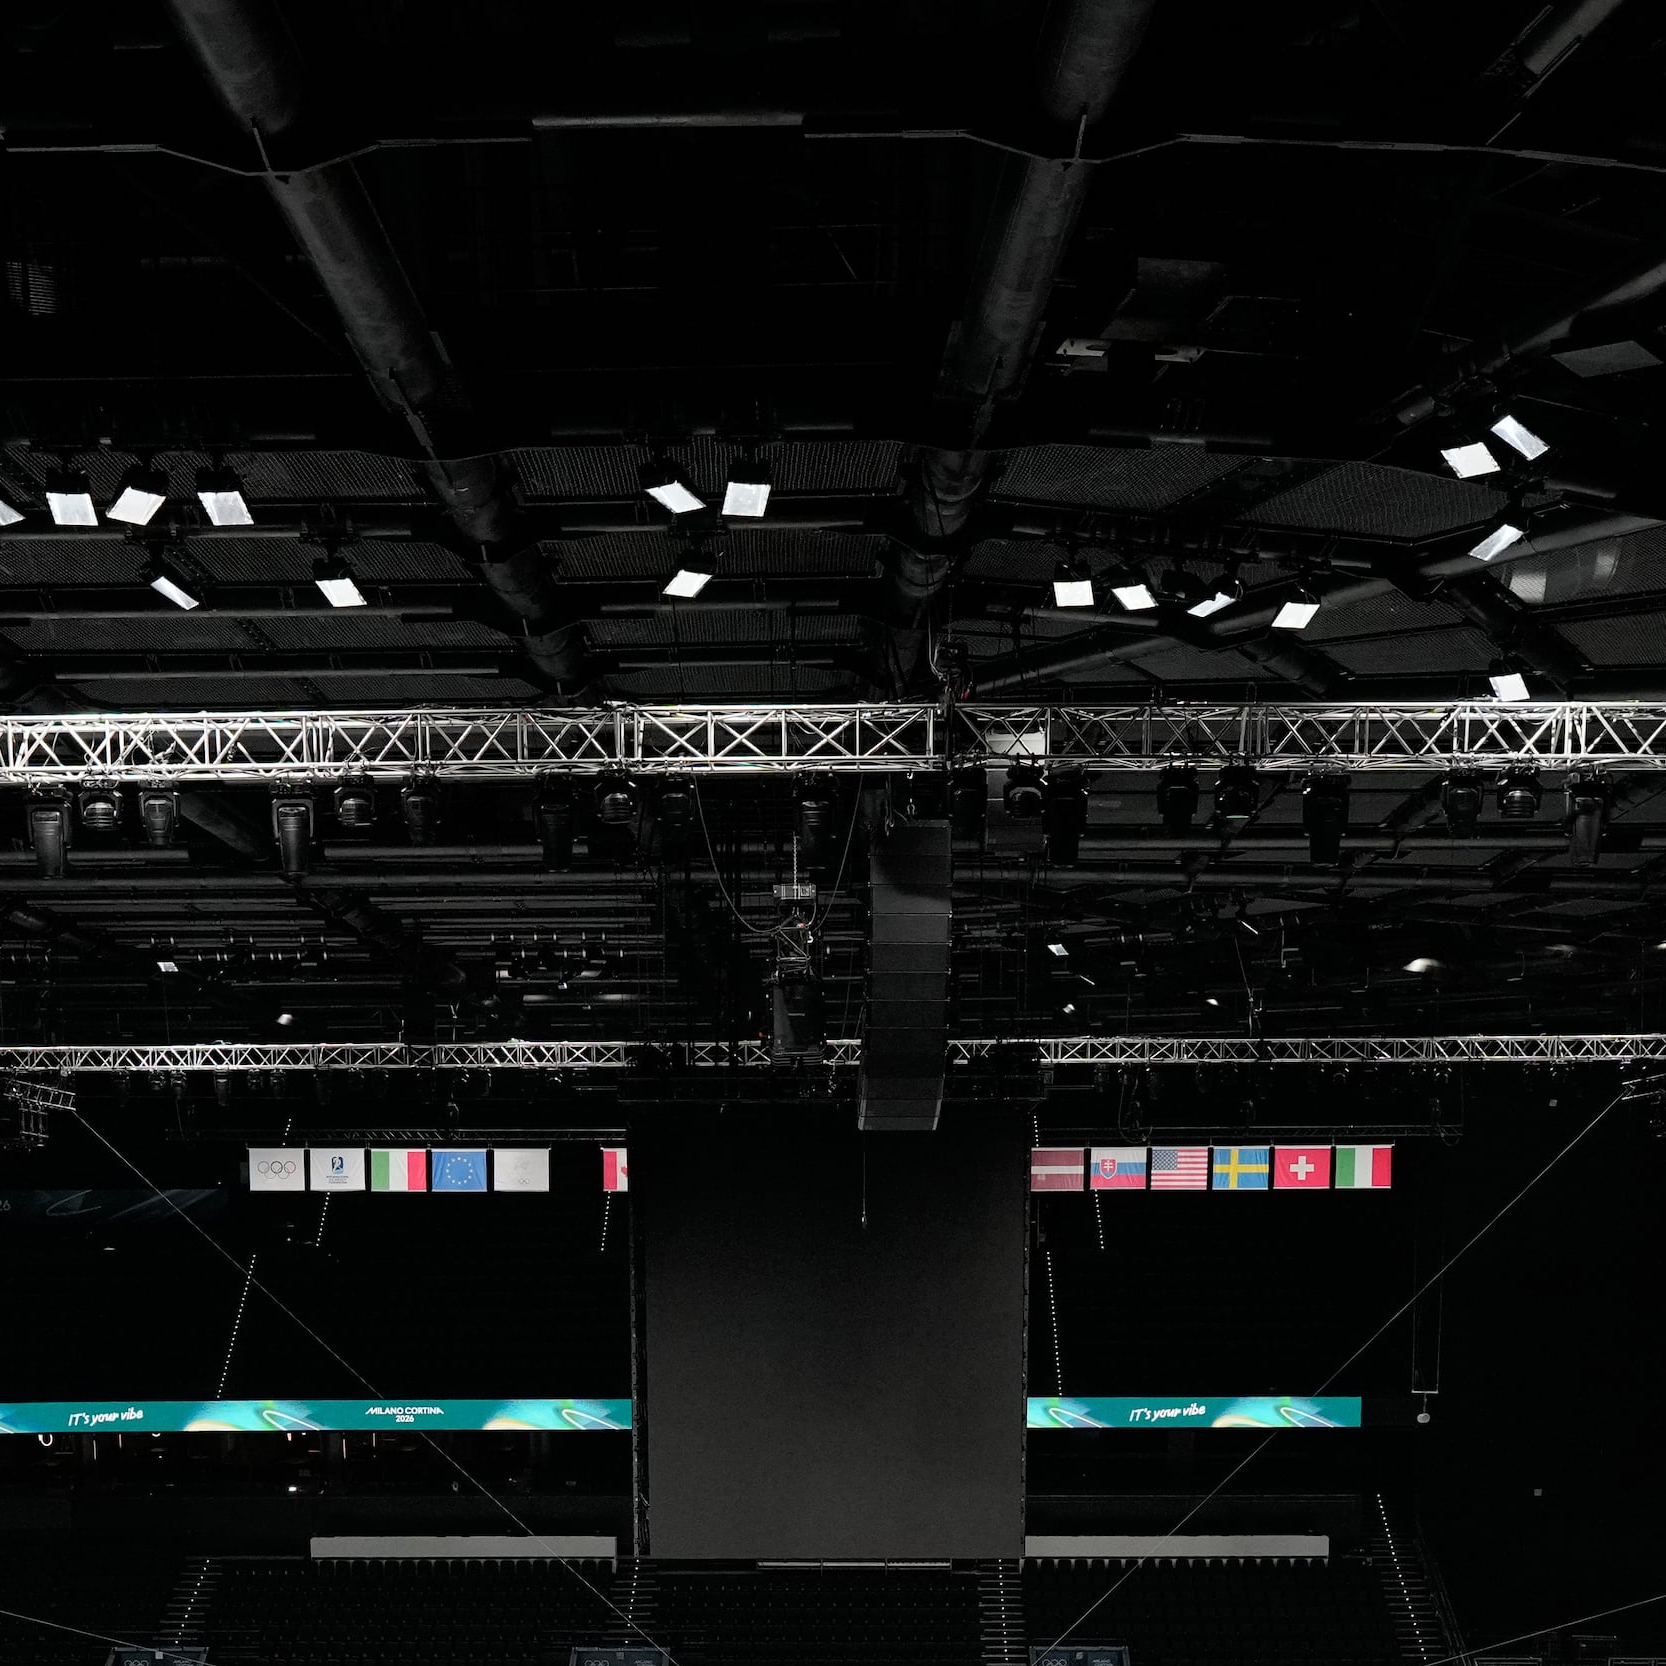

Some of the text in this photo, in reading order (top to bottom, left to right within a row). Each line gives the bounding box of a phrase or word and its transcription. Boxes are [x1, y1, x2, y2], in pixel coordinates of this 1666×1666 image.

[68, 1407, 144, 1427] IT's your vibe
[365, 1407, 445, 1415] MILANO CORTINA
[1129, 1403, 1207, 1423] IT's your vibe
[395, 1415, 415, 1423] 2026
